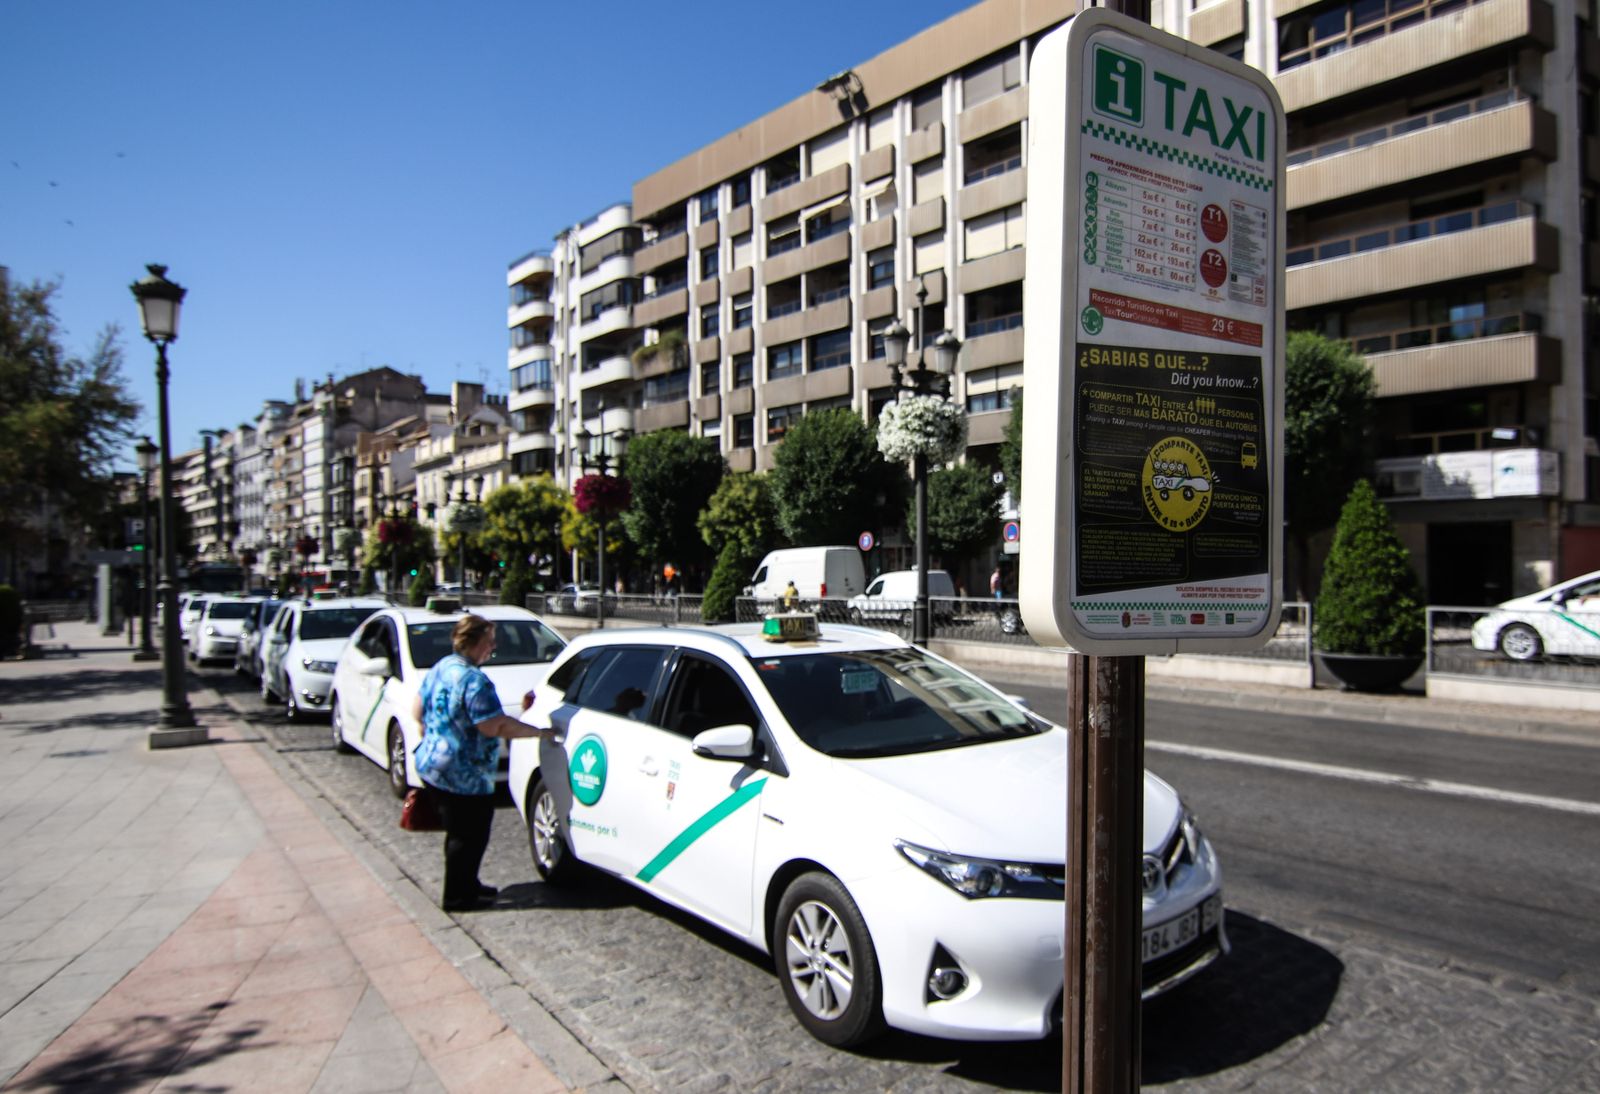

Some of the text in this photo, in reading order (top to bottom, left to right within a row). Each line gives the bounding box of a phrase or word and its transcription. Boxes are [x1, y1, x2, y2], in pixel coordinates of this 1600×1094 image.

[1153, 71, 1265, 163] TAXI
[1208, 207, 1222, 223] T1
[1207, 252, 1222, 266] T2
[1092, 292, 1125, 307] Recorrido
[1166, 309, 1178, 318] Taxi
[1212, 318, 1224, 333] 29
[1227, 321, 1234, 336] €
[1171, 372, 1259, 390] Did you know...?
[1089, 390, 1255, 420] COMPARTIR TAXI ENTRE 4 PERSONAS
[1089, 402, 1115, 414] PUEDE
[1116, 406, 1132, 416] SER
[1151, 407, 1198, 424] BARATO
[1199, 417, 1215, 426] QUE
[1215, 420, 1224, 428] EL
[1112, 417, 1126, 425] TAXI
[1184, 426, 1210, 436] CHEAPER
[1154, 440, 1195, 456] COMPARTE
[1195, 453, 1208, 476] TAXI
[1154, 478, 1174, 487] TAXI
[1145, 485, 1164, 519] ENTRE
[1186, 495, 1209, 528] BARATO
[783, 618, 805, 633] TAXI
